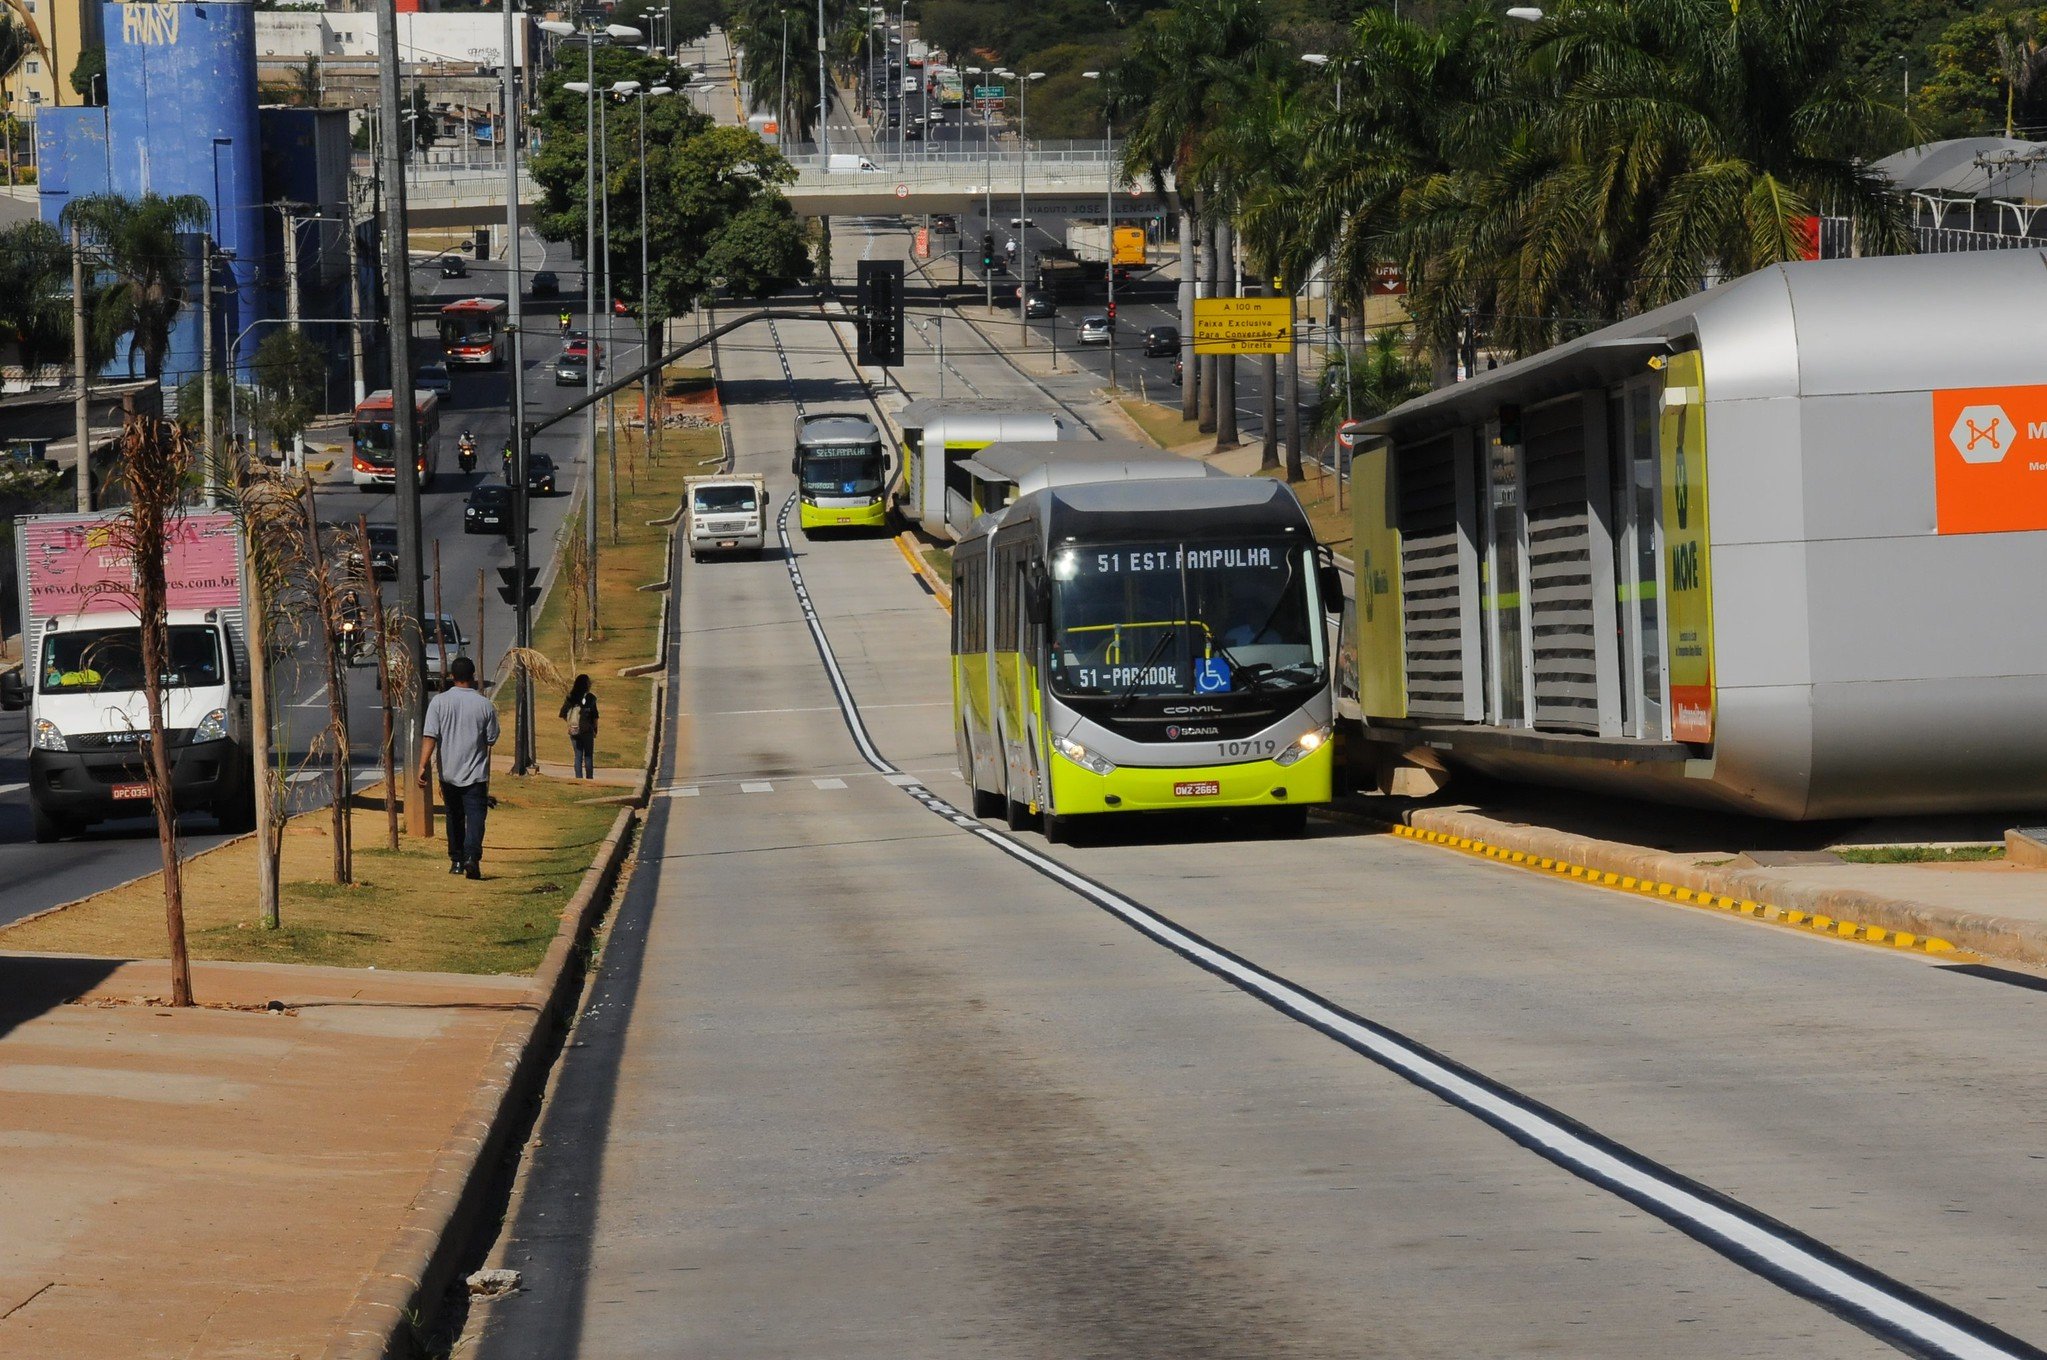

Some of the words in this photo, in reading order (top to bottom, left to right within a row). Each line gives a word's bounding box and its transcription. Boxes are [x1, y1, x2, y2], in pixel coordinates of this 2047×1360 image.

[1027, 206, 1067, 214] VIADUTO
[1224, 303, 1230, 311] A
[1236, 303, 1251, 311] 100
[1228, 319, 1272, 327] Exclusiva
[1225, 329, 1272, 338] Conversão
[1241, 341, 1272, 349] Direita
[1098, 553, 1119, 573] 51
[1130, 551, 1171, 572] EST.
[1673, 540, 1699, 592] MOVE
[1080, 668, 1097, 688] 51
[1163, 705, 1222, 714] COMIL
[1181, 727, 1219, 736] SCANIA
[1218, 740, 1276, 757] 10719
